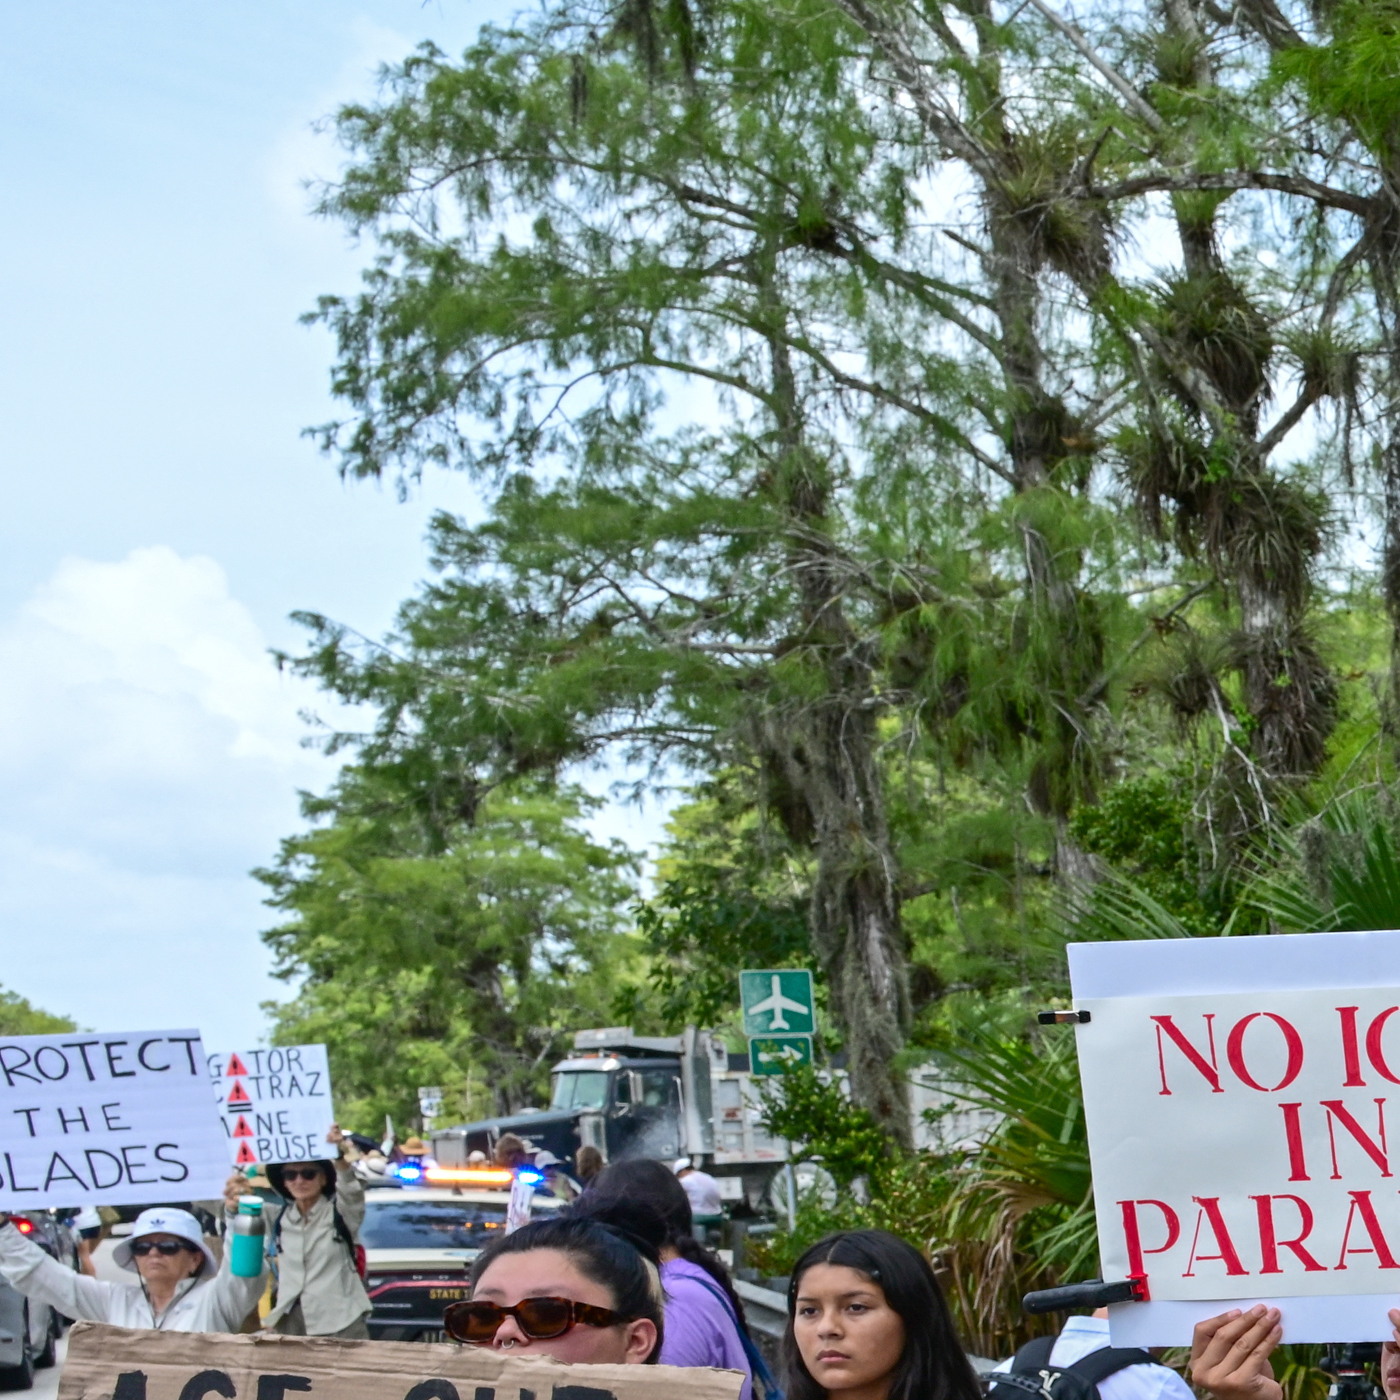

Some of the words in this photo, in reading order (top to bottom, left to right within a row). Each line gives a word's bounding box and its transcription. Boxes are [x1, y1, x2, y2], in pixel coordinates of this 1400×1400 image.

[1150, 1011, 1304, 1096] NO
[14, 1102, 132, 1137] THE
[1278, 1098, 1394, 1182] IN
[0, 1143, 189, 1192] LADES
[429, 1288, 461, 1300] STATE
